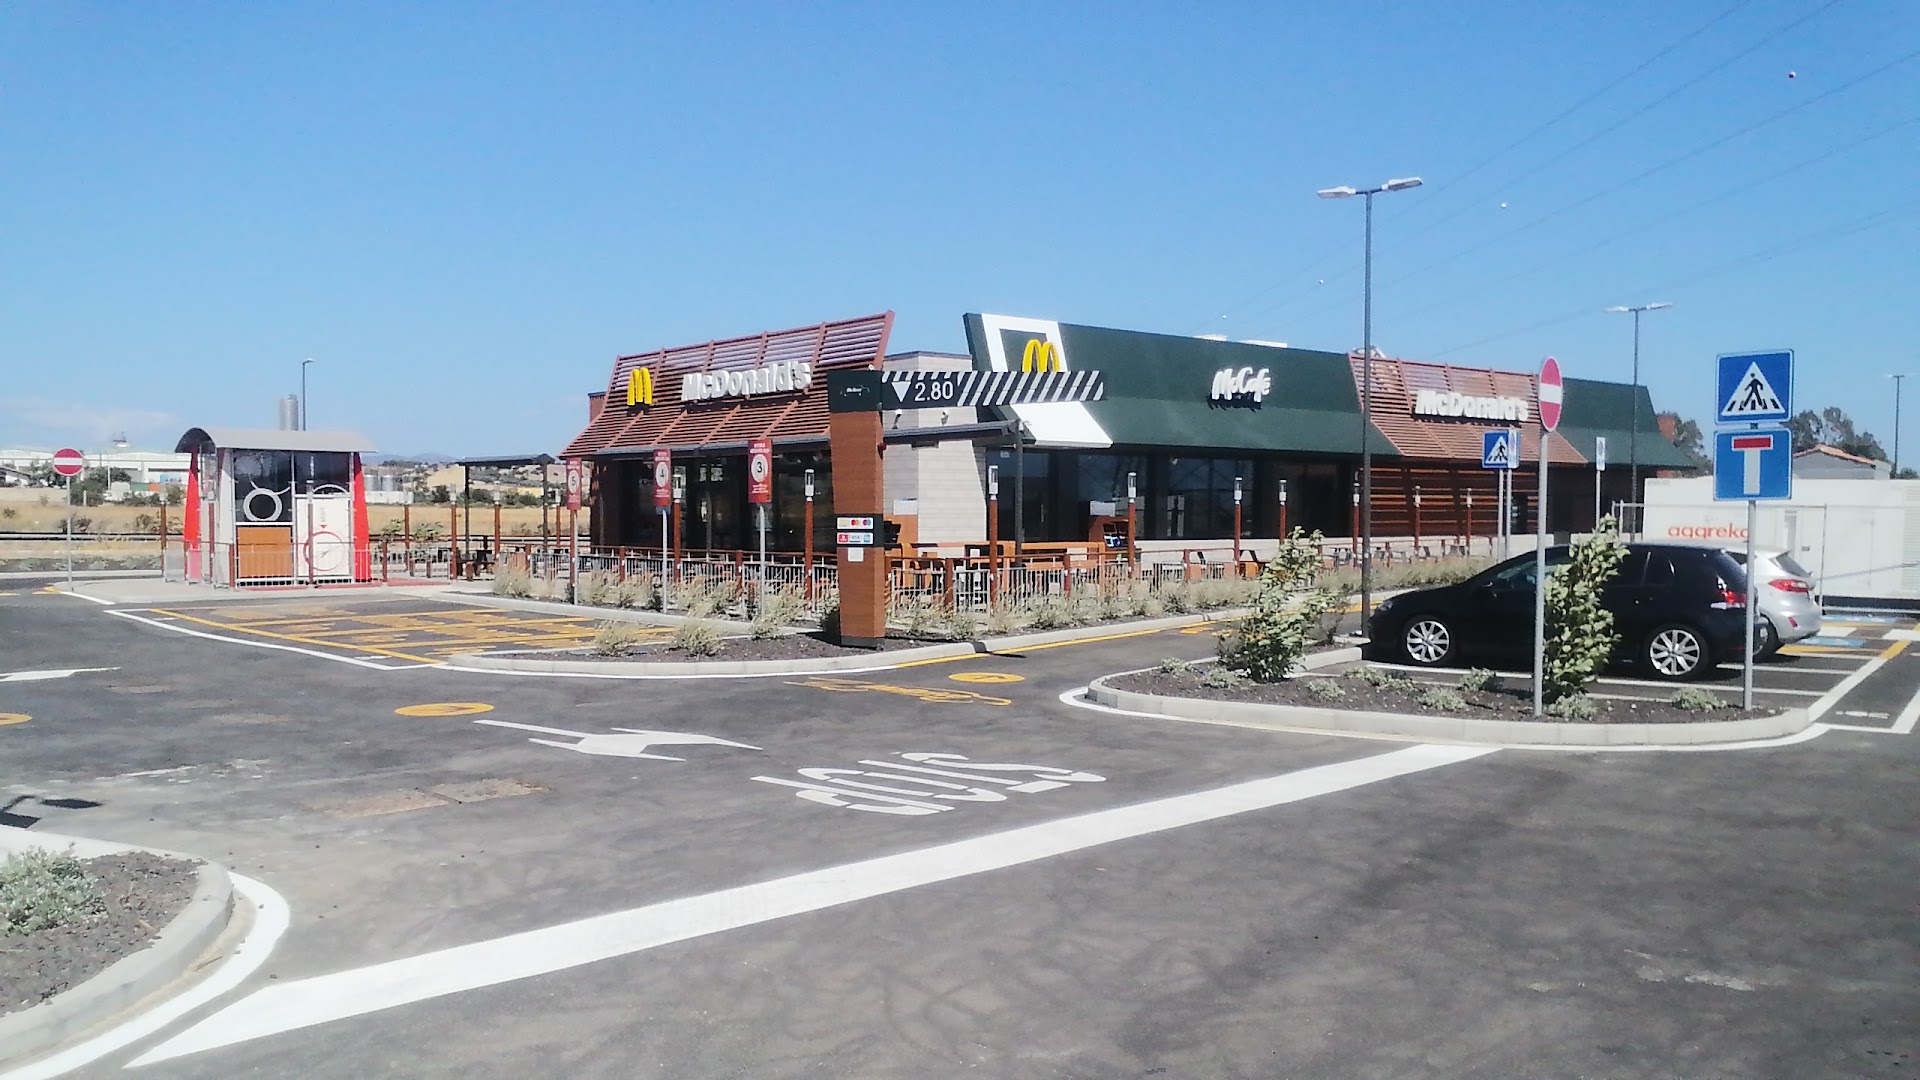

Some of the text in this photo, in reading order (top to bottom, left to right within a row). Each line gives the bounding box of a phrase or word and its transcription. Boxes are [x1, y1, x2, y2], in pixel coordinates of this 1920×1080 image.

[681, 360, 811, 402] McDonald's
[914, 381, 954, 402] 2.80
[1414, 389, 1528, 421] McDonald's
[756, 461, 763, 473] 3
[750, 752, 1106, 816] STOP
